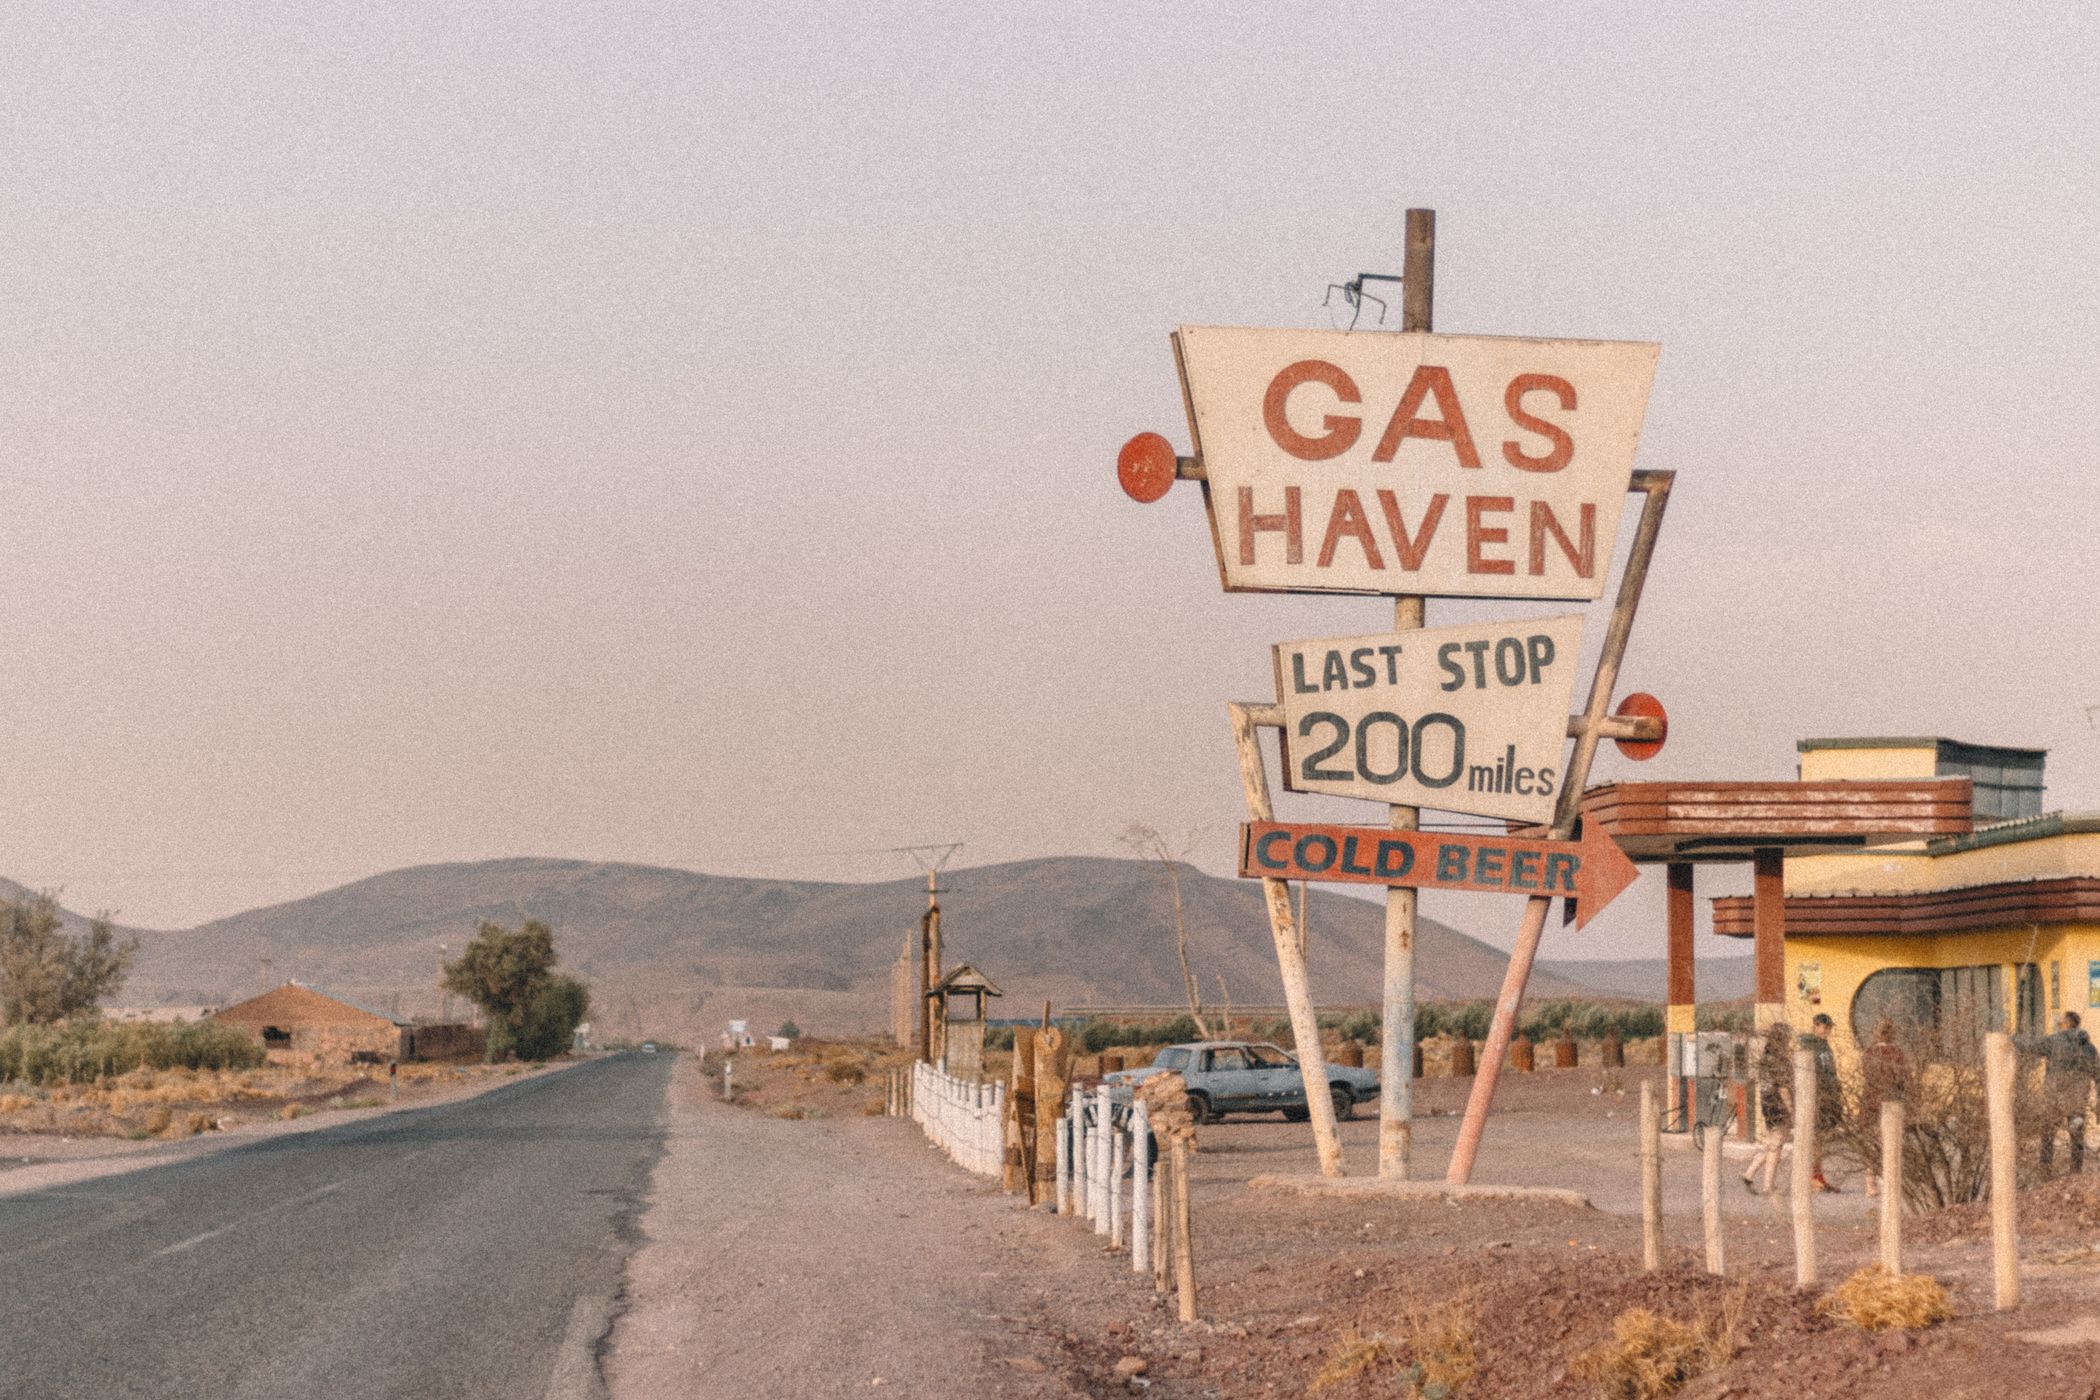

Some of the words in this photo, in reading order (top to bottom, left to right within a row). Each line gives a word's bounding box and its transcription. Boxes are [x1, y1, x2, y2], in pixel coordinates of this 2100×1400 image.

[1263, 359, 1577, 473] GAS
[1238, 486, 1596, 579] HAVEN
[1292, 646, 1402, 694] LAST
[1437, 635, 1555, 691] STOP
[1300, 711, 1466, 788] 200
[1469, 745, 1555, 797] miles
[1256, 831, 1415, 878] COLD
[1437, 844, 1580, 891] BEER
